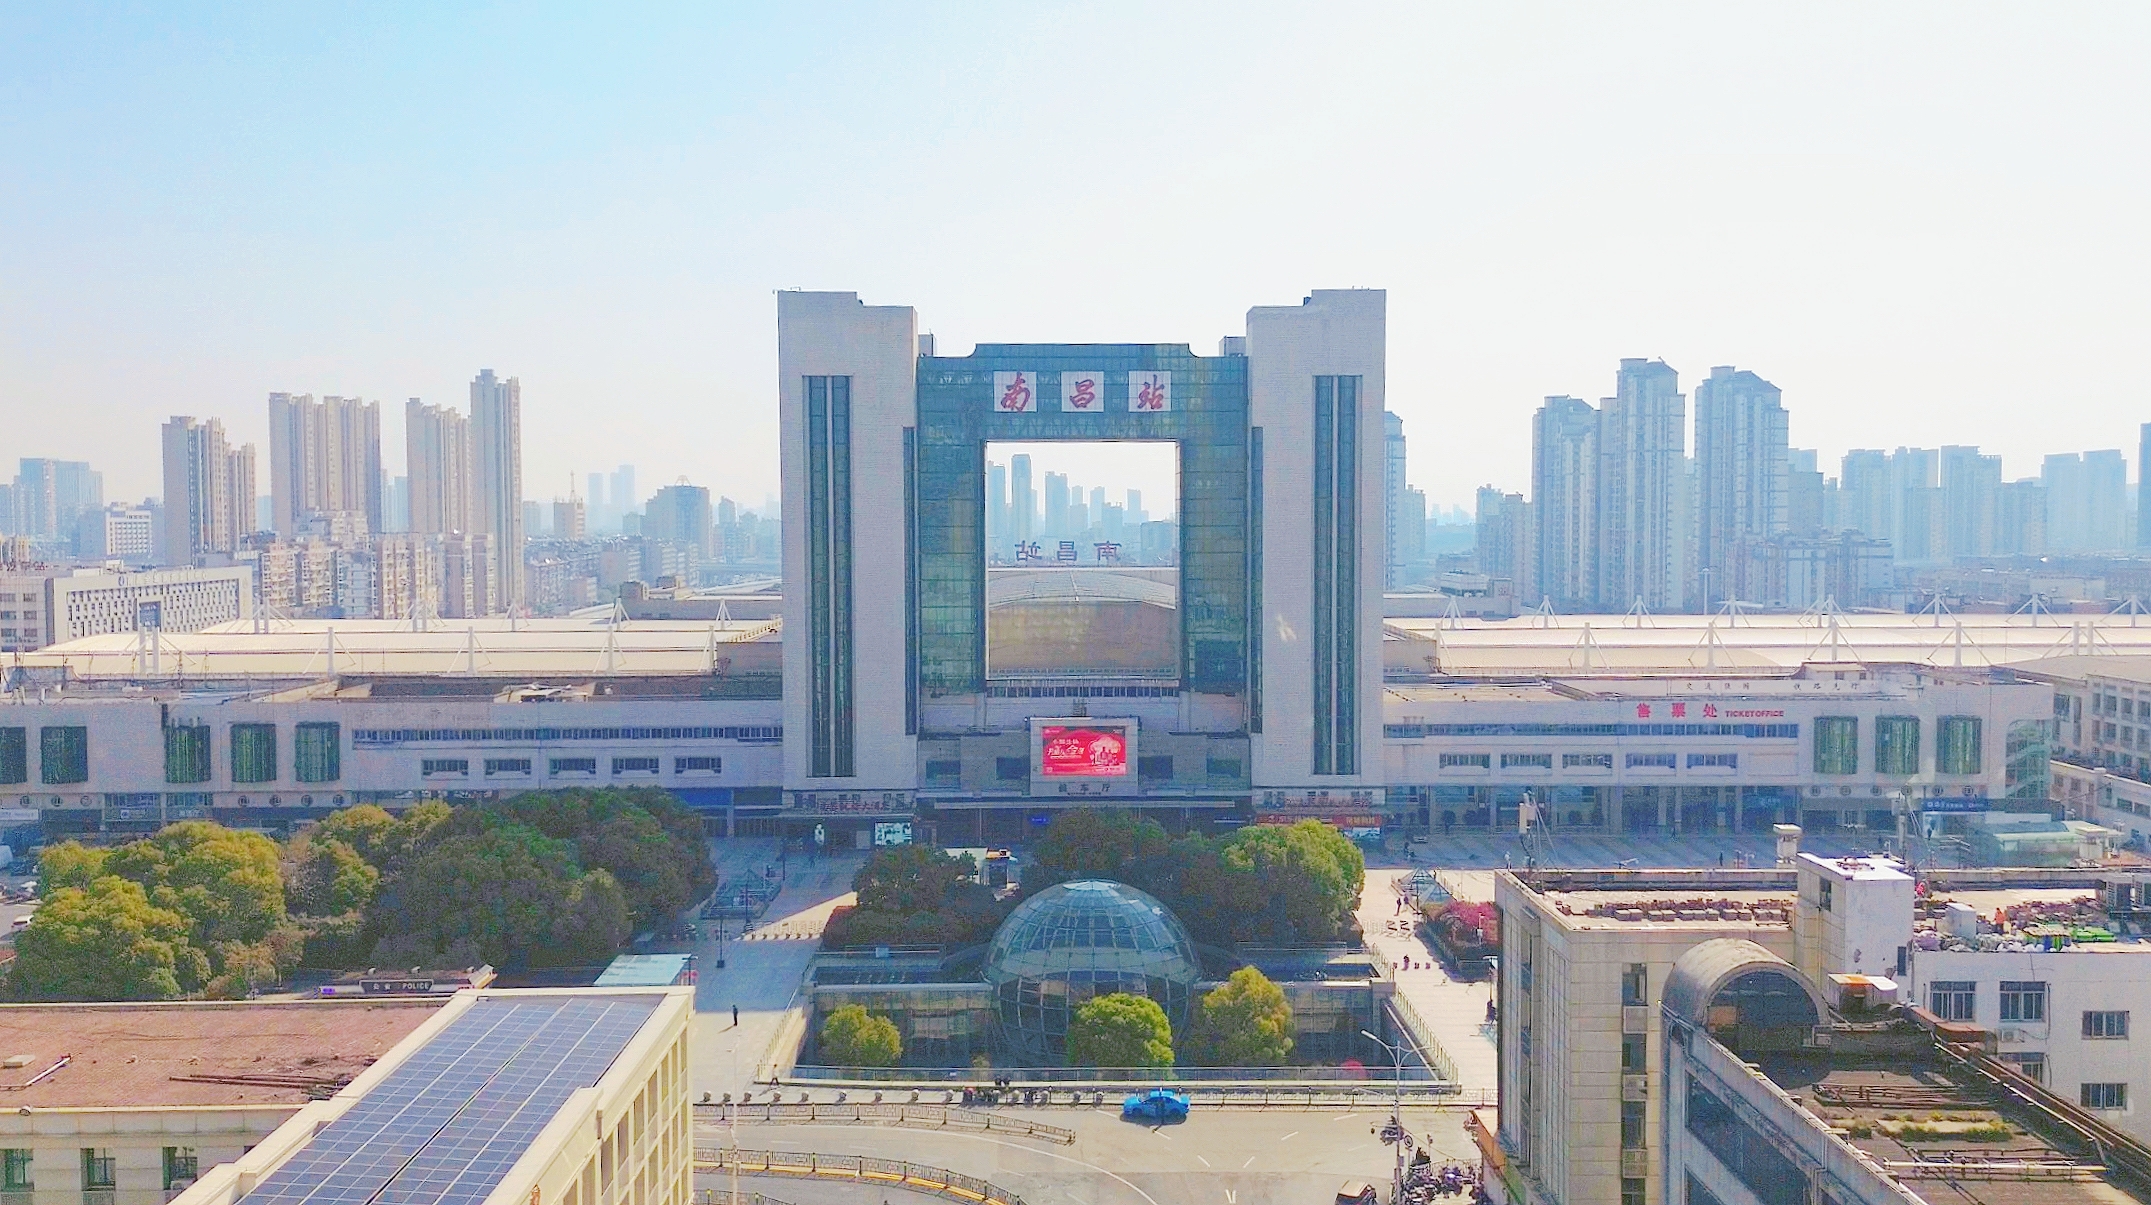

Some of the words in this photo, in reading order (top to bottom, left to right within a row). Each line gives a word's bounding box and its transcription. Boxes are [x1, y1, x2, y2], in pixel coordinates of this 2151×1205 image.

[1000, 371, 1165, 412] 南昌站
[1636, 702, 1718, 718] 售票处
[402, 982, 429, 991] POLICE
